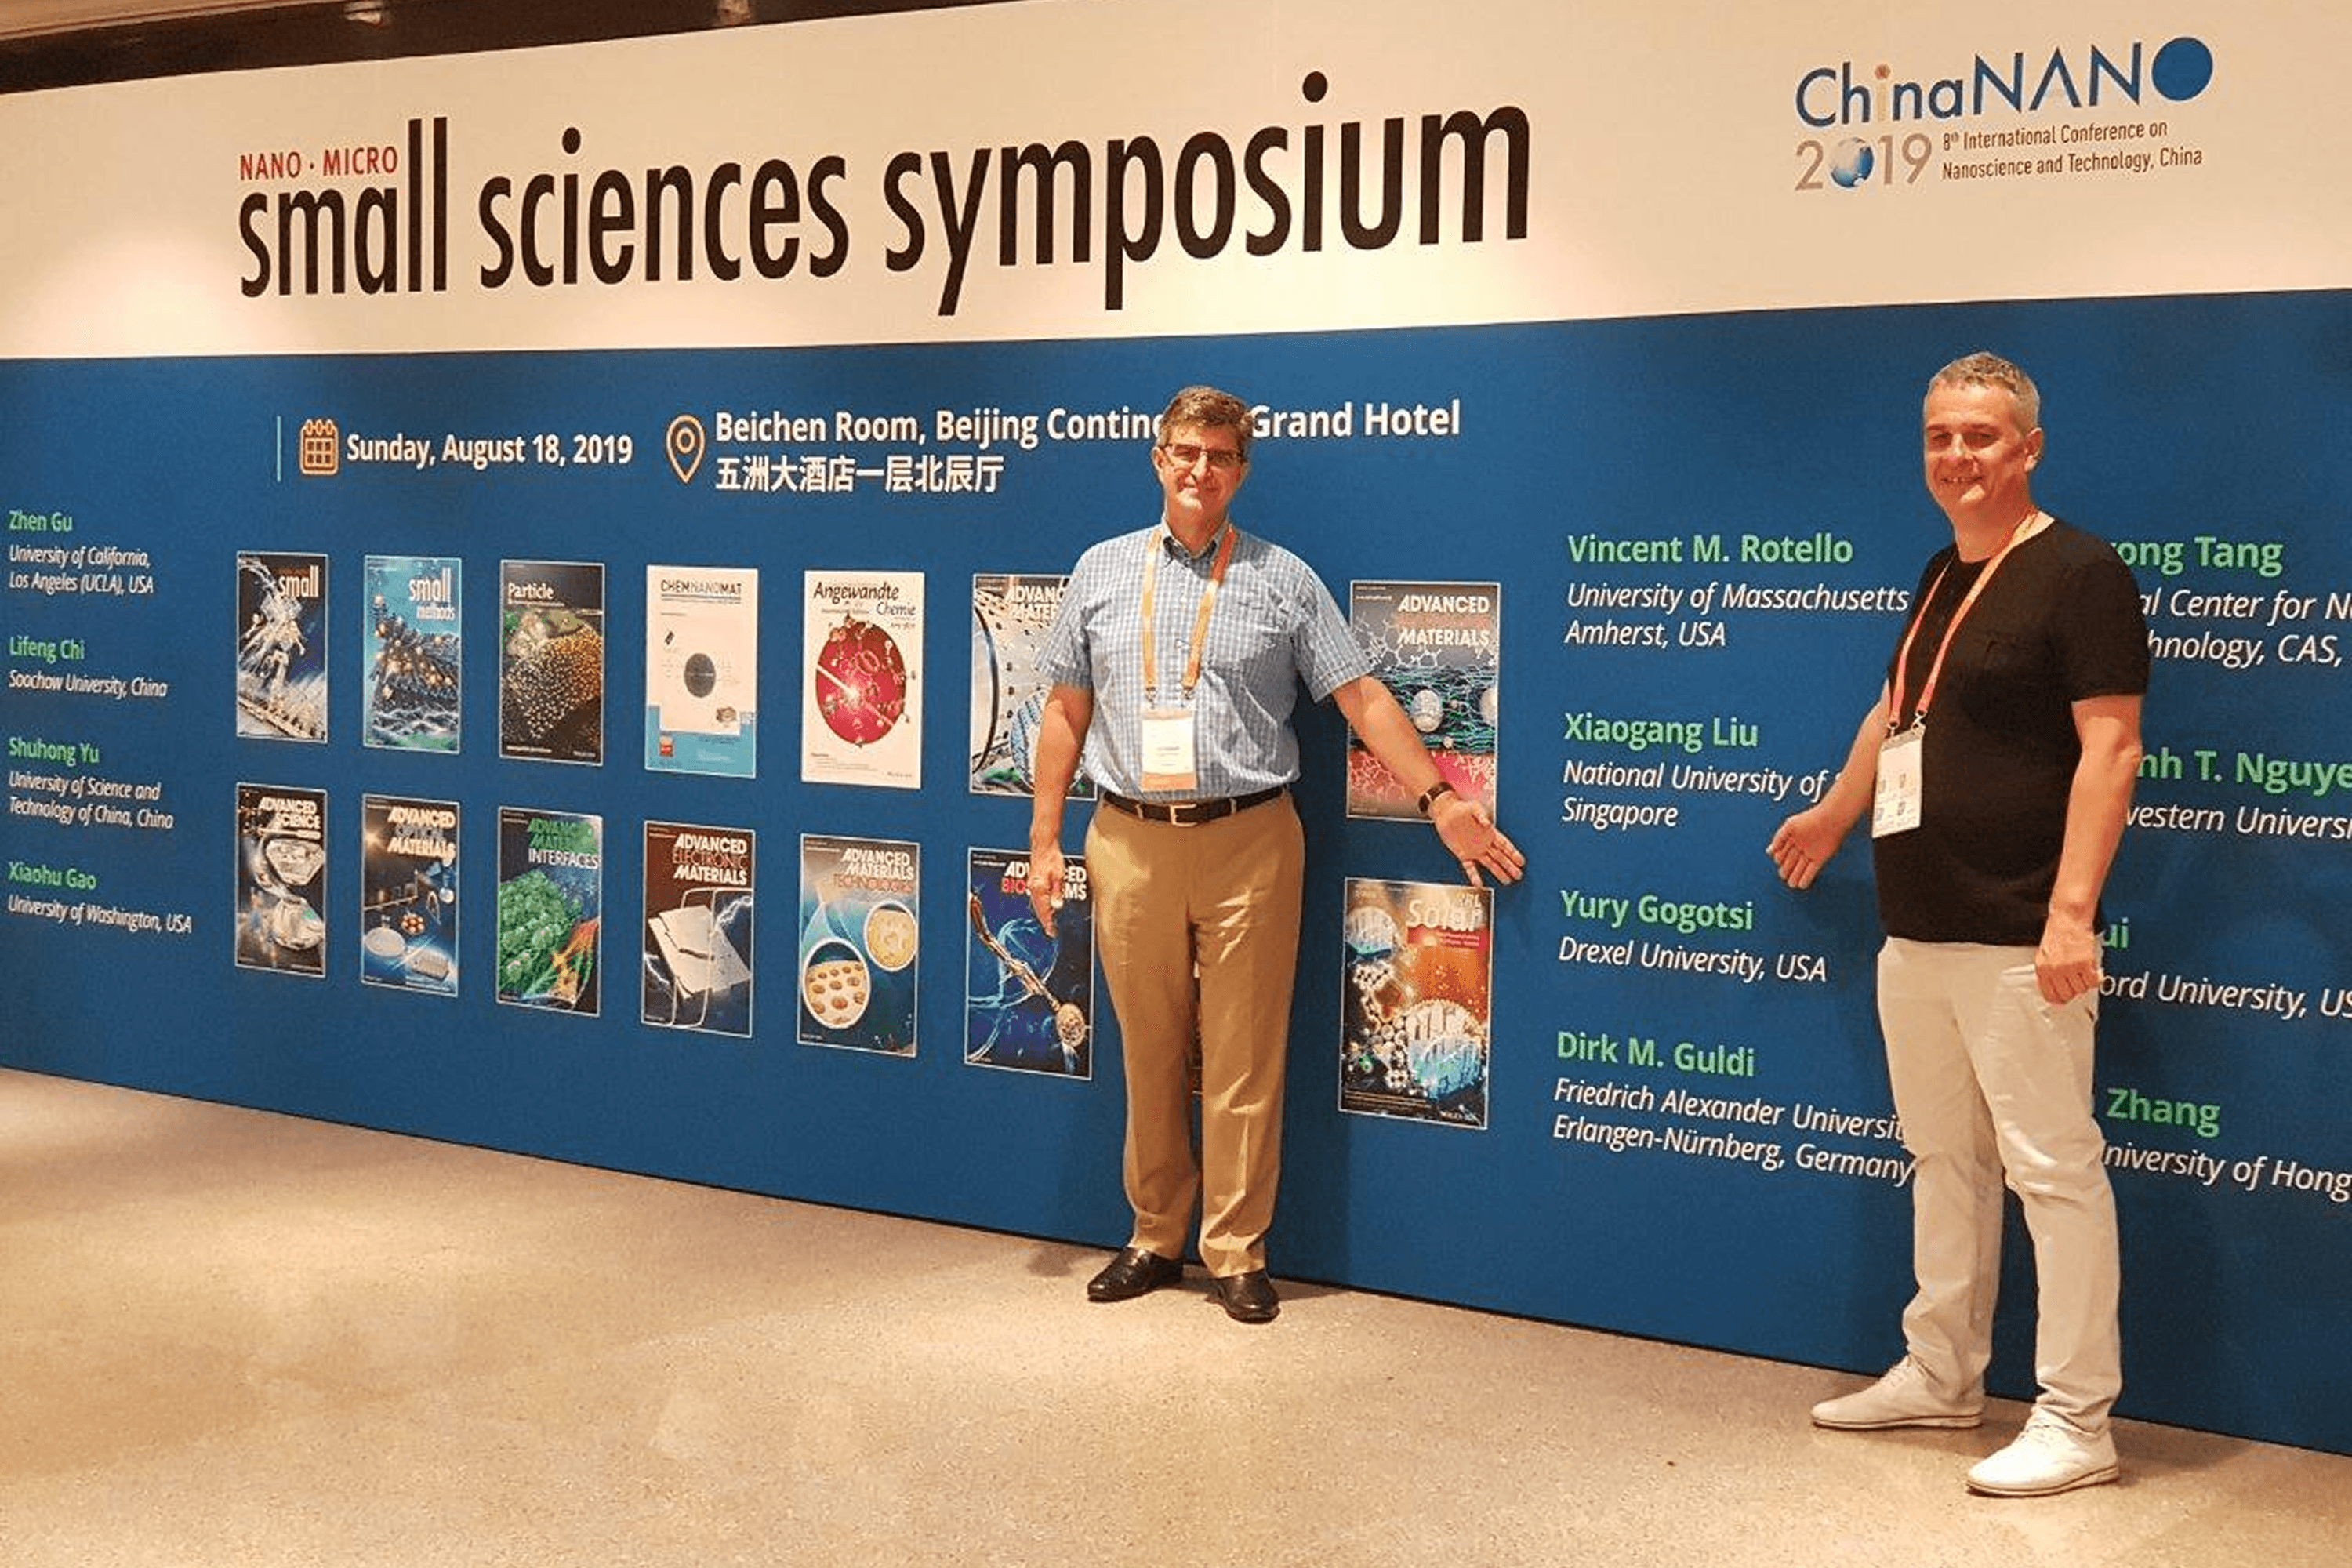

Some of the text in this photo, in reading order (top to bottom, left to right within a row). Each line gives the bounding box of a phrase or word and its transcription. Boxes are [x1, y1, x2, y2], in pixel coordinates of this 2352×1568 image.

[1963, 125, 2057, 151] International
[2060, 122, 2145, 143] Conference
[2149, 122, 2168, 138] on
[240, 151, 302, 181] NANO
[323, 146, 398, 176] MICRO
[1794, 133, 1933, 191] 2019
[1942, 145, 2203, 180] Nanoscience and Technology, China
[239, 71, 1530, 317] small sciences symposium
[716, 410, 826, 442] Beichen
[835, 411, 926, 445] Room,
[936, 408, 1040, 450] Beijing
[1251, 402, 1351, 437] Grand
[1365, 398, 1460, 436] Hotel
[347, 433, 633, 470] Sunday, August 18, 2019
[715, 454, 1004, 493] 五洲大酒店一层北辰厅
[9, 509, 73, 532] Zhen Gu
[9, 544, 151, 571] University of California,
[1567, 532, 1853, 563] Vincent M. Rotello
[2111, 536, 2284, 578] ong Tang
[9, 571, 29, 589] Los
[31, 571, 78, 596] Angeles
[128, 575, 154, 594] USA
[278, 565, 319, 597] small
[408, 567, 451, 602] small
[508, 583, 554, 600] Particle
[814, 582, 899, 604] Angewandte
[877, 601, 916, 616] Chemie
[1397, 594, 1490, 614] ADVANCED
[1567, 581, 1910, 615] University of Massachusetts
[2170, 589, 2265, 618] Center
[2266, 590, 2318, 627] for
[2325, 592, 2352, 620] N
[9, 635, 85, 665] Lifeng Chi
[1397, 628, 1490, 648] MATERIALS
[1563, 619, 1726, 649] Amherst, USA
[2278, 634, 2343, 668] CAS,
[9, 669, 168, 700] Soochow University, China
[1564, 711, 1758, 753] Xiaogang Liu
[8, 736, 100, 768] Shuhong Yu
[2194, 750, 2223, 782] T.
[9, 771, 162, 800] University of Science and
[1563, 760, 1829, 803] National University of
[9, 796, 174, 829] Technology of China, China
[258, 797, 318, 815] ADVANCED
[1561, 797, 1679, 831] Singapore
[528, 848, 599, 869] INTERFACES
[674, 833, 747, 854] ADVANCED
[840, 848, 911, 866] ADVANCED
[8, 861, 97, 891] Xiaohu Gao
[673, 865, 747, 886] MATERIALS
[844, 862, 915, 880] MATERIALS
[7, 895, 192, 934] University of Washington, USA
[1559, 889, 1753, 934] Yury Gogotsi
[1559, 936, 1826, 983] Drexel University, USA
[2158, 974, 2307, 1020] University,
[1557, 1031, 1755, 1077] Dirk M. Guldi
[1554, 1077, 1906, 1149] Friedrich Alexander Universit
[2107, 1088, 2221, 1138] Zhang
[1553, 1114, 1914, 1188] Erlangen-Nürnberg, Germany
[2104, 1141, 2352, 1203] niversity of Hong
